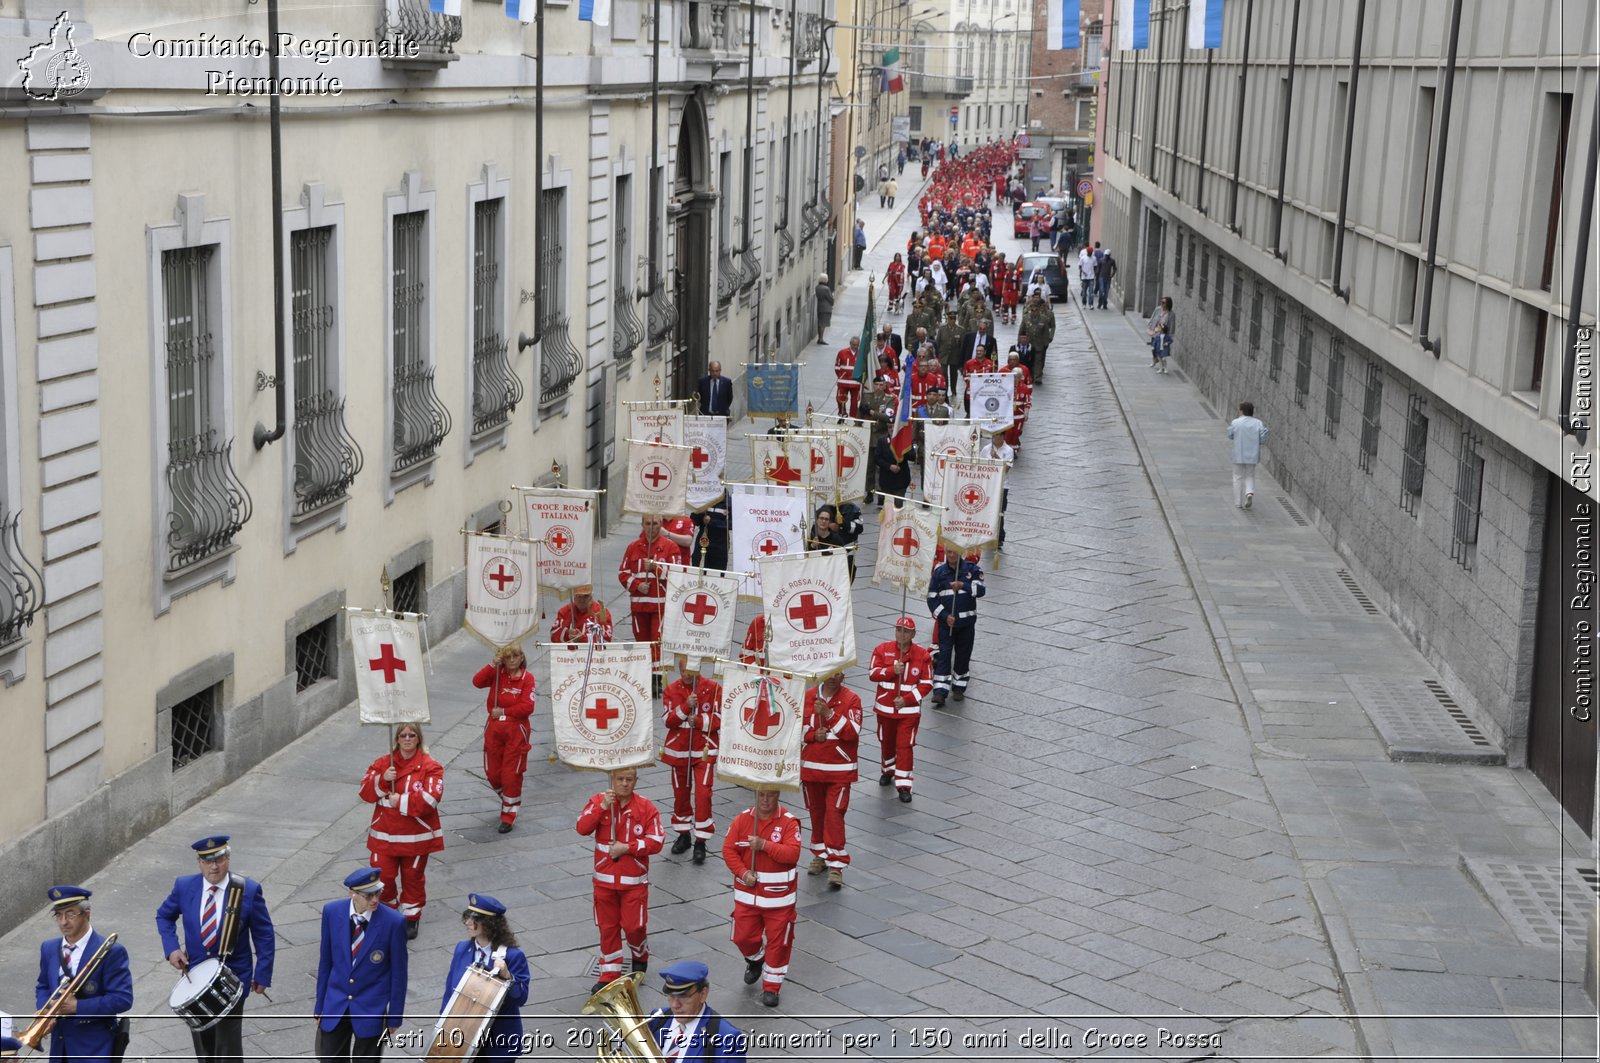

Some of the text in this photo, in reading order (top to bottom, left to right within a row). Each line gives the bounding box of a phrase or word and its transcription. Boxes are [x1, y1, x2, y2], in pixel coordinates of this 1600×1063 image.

[950, 463, 975, 471] CROCE
[957, 472, 990, 480] ITALIANA
[563, 504, 589, 512] ROSSA
[541, 512, 578, 520] ITALIANA
[948, 520, 990, 529] MONTIGLIO
[944, 526, 992, 536] MONFERRATO
[564, 560, 586, 568] LOCALE
[670, 584, 687, 602] CROCE
[710, 582, 730, 610] ITALIANA
[772, 578, 841, 608] CROCE ROSSA ITALIANA
[686, 630, 710, 638] GRUPPO
[790, 638, 833, 648] DELEGAZIONE
[620, 654, 646, 662] SOCCORSO
[792, 651, 834, 662] ISOLA D'ASTI
[554, 674, 577, 702] CROCE
[614, 670, 650, 702] ITALIANA
[724, 685, 744, 710] CROCE
[774, 684, 802, 720] ITALIANA
[570, 696, 596, 741] CONVENZIONE
[589, 684, 621, 696] GINEVRA
[558, 744, 652, 756] COMITATO PROVINCIALE
[732, 744, 778, 756] DELEGAZIONE
[720, 756, 772, 770] MONTEGROSSO
